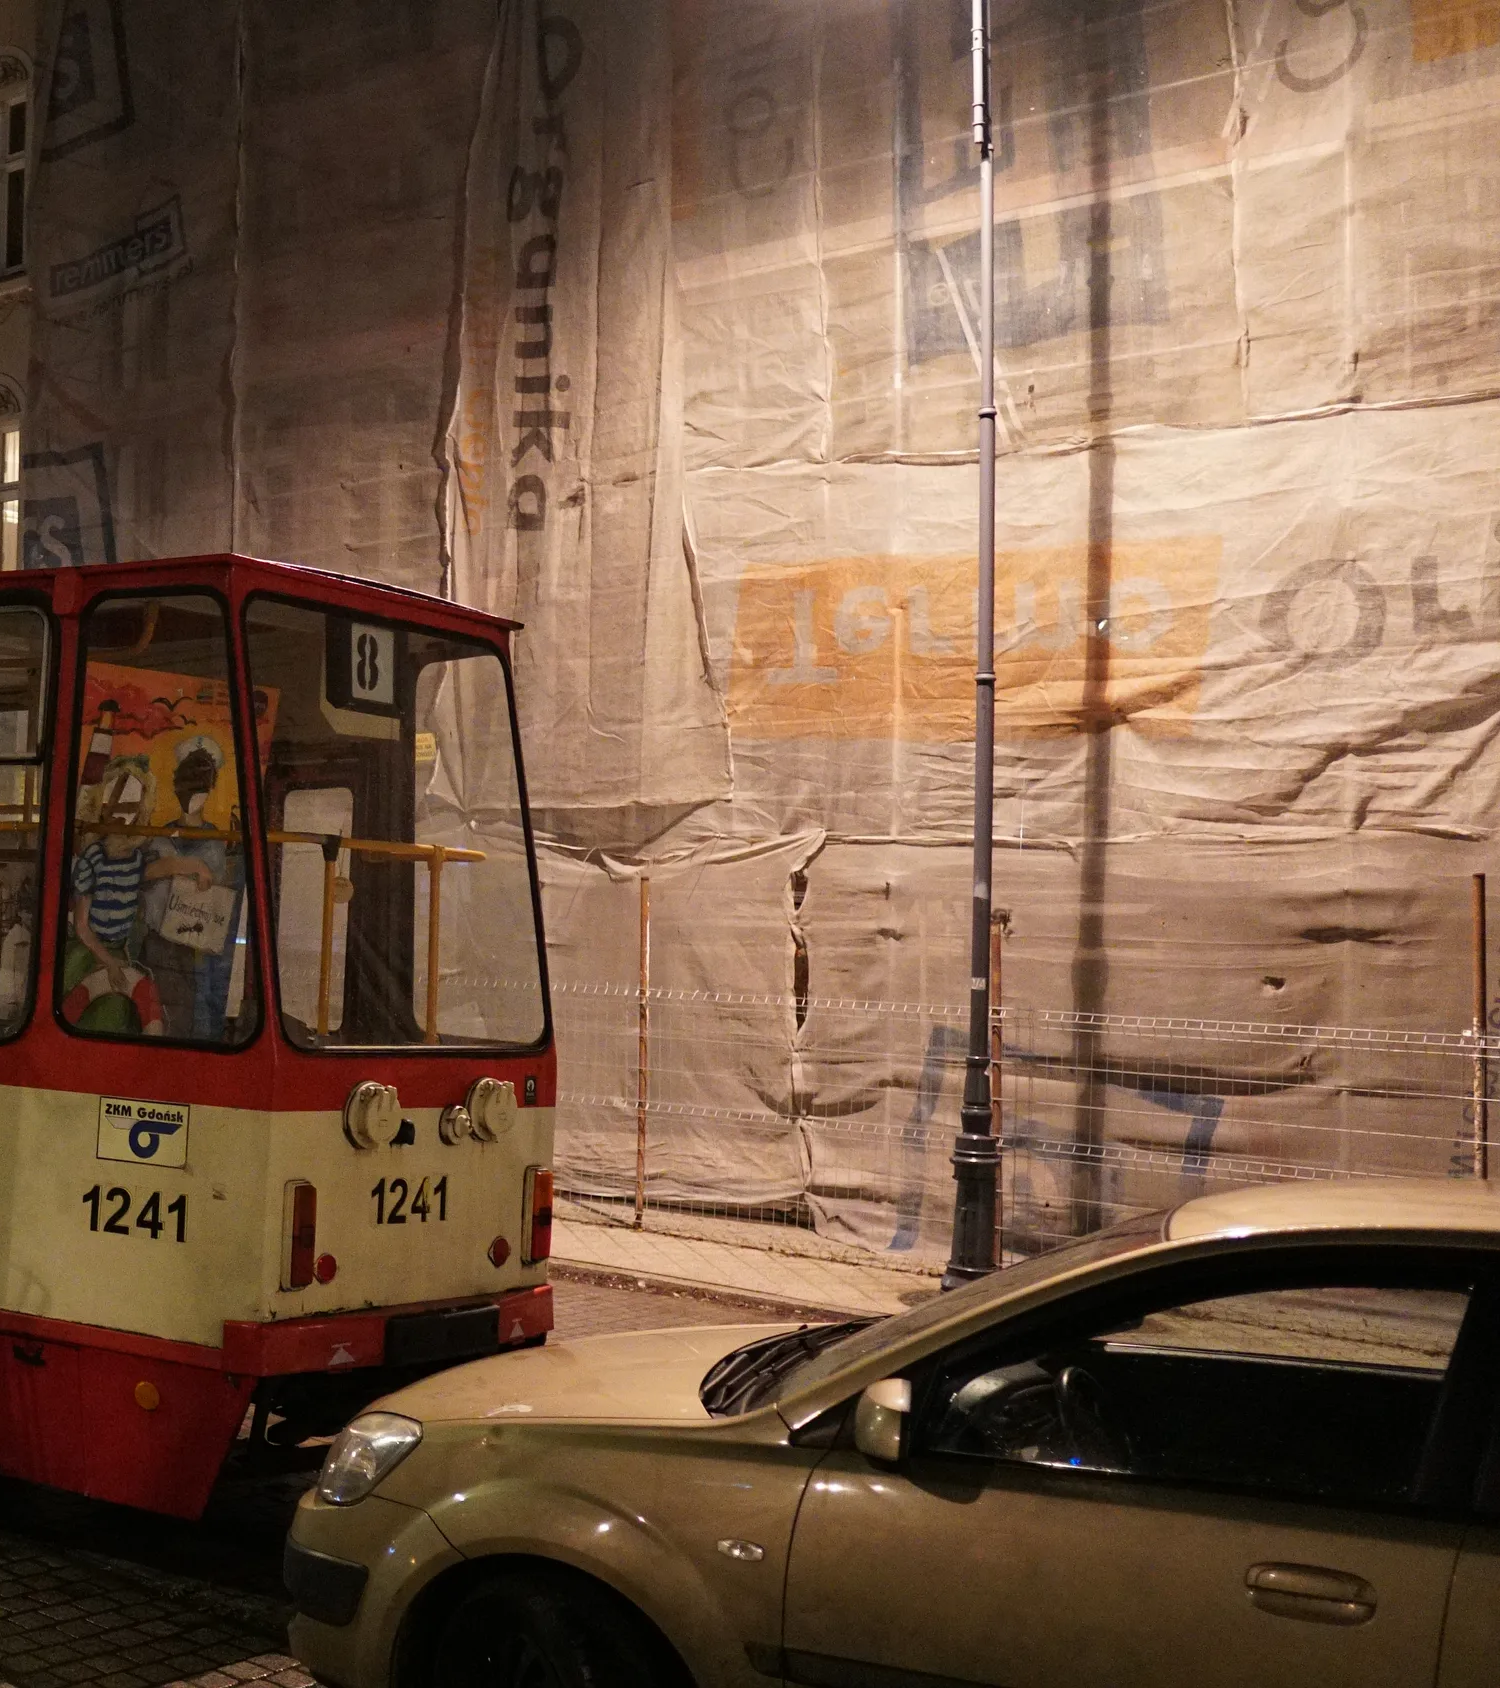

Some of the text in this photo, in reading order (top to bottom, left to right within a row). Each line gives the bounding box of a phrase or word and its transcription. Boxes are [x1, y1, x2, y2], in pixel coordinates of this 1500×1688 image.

[55, 227, 168, 291] remmers
[507, 14, 587, 533] Organika
[357, 633, 379, 691] 8
[105, 1103, 184, 1123] ZKM Gdańsk
[82, 1184, 190, 1243] 1241
[372, 1176, 449, 1225] 1241
